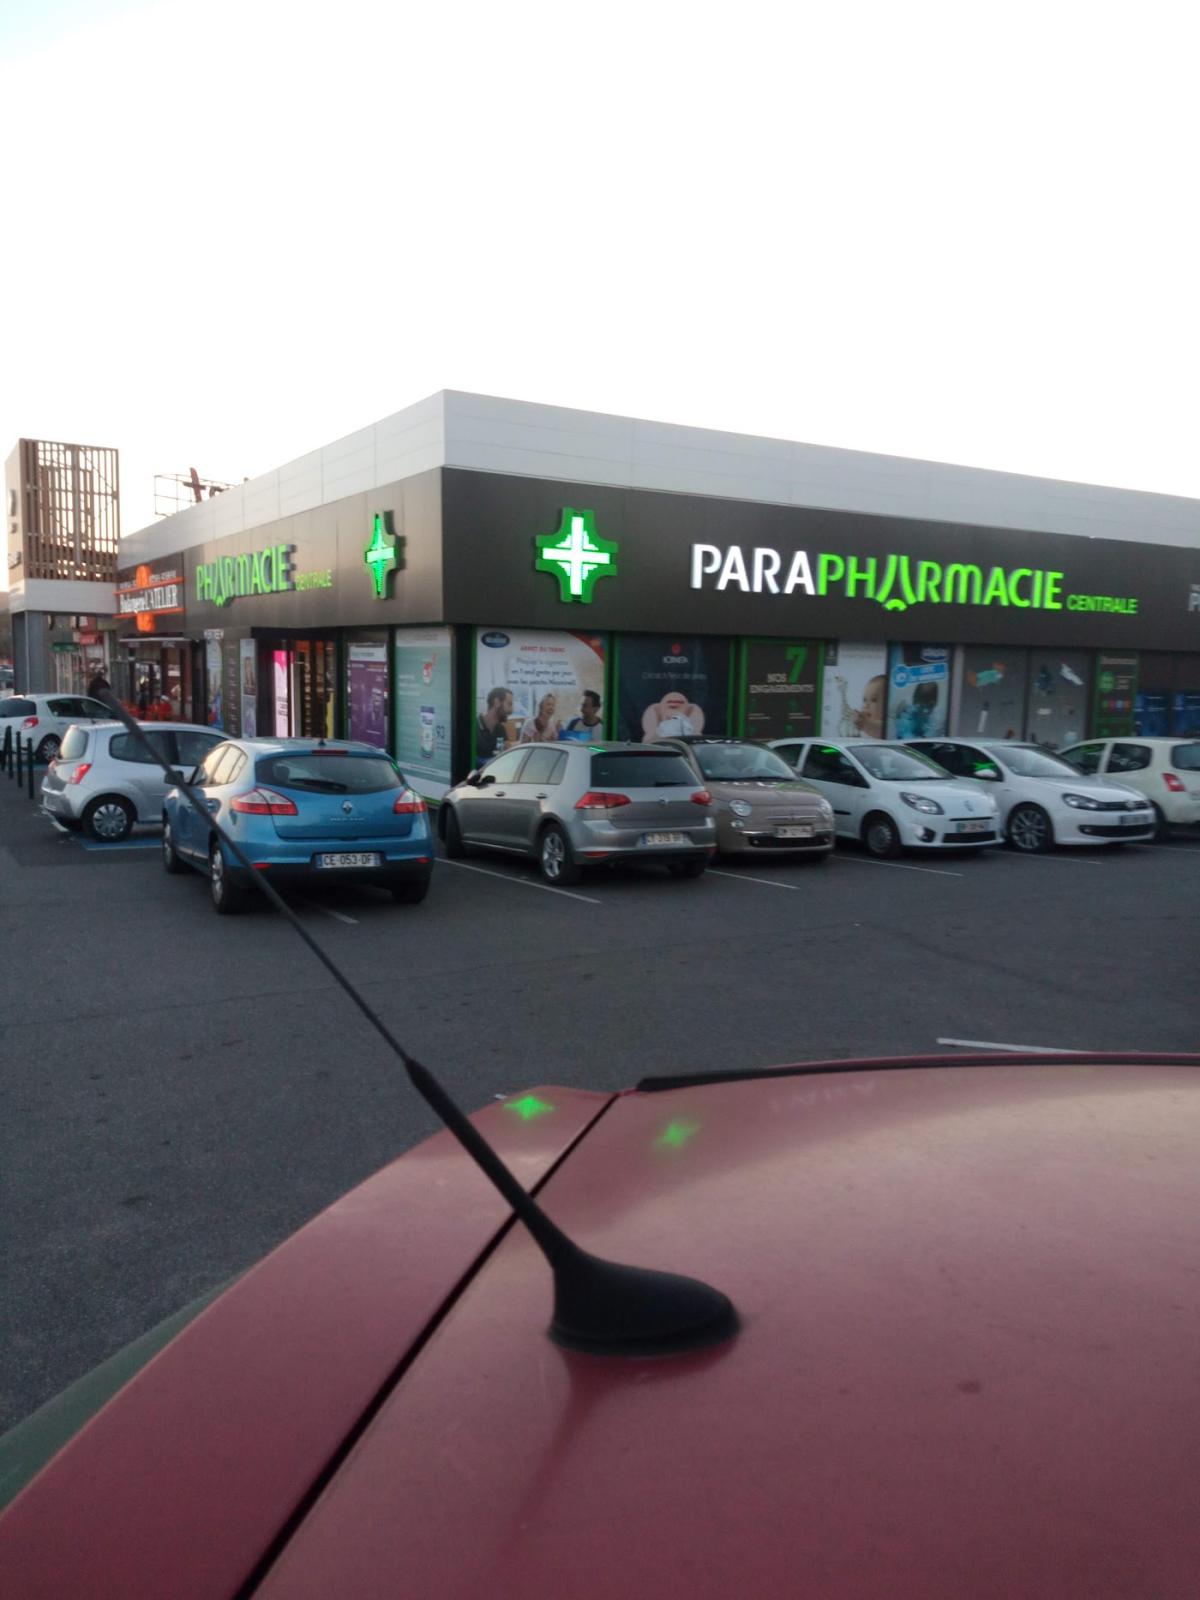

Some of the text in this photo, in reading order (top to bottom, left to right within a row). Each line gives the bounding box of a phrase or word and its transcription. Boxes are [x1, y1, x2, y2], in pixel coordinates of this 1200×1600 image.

[196, 545, 295, 607] PHARMACIE
[690, 543, 1138, 614] PARAPHARMACIE CENTRALE
[786, 646, 808, 683] 7
